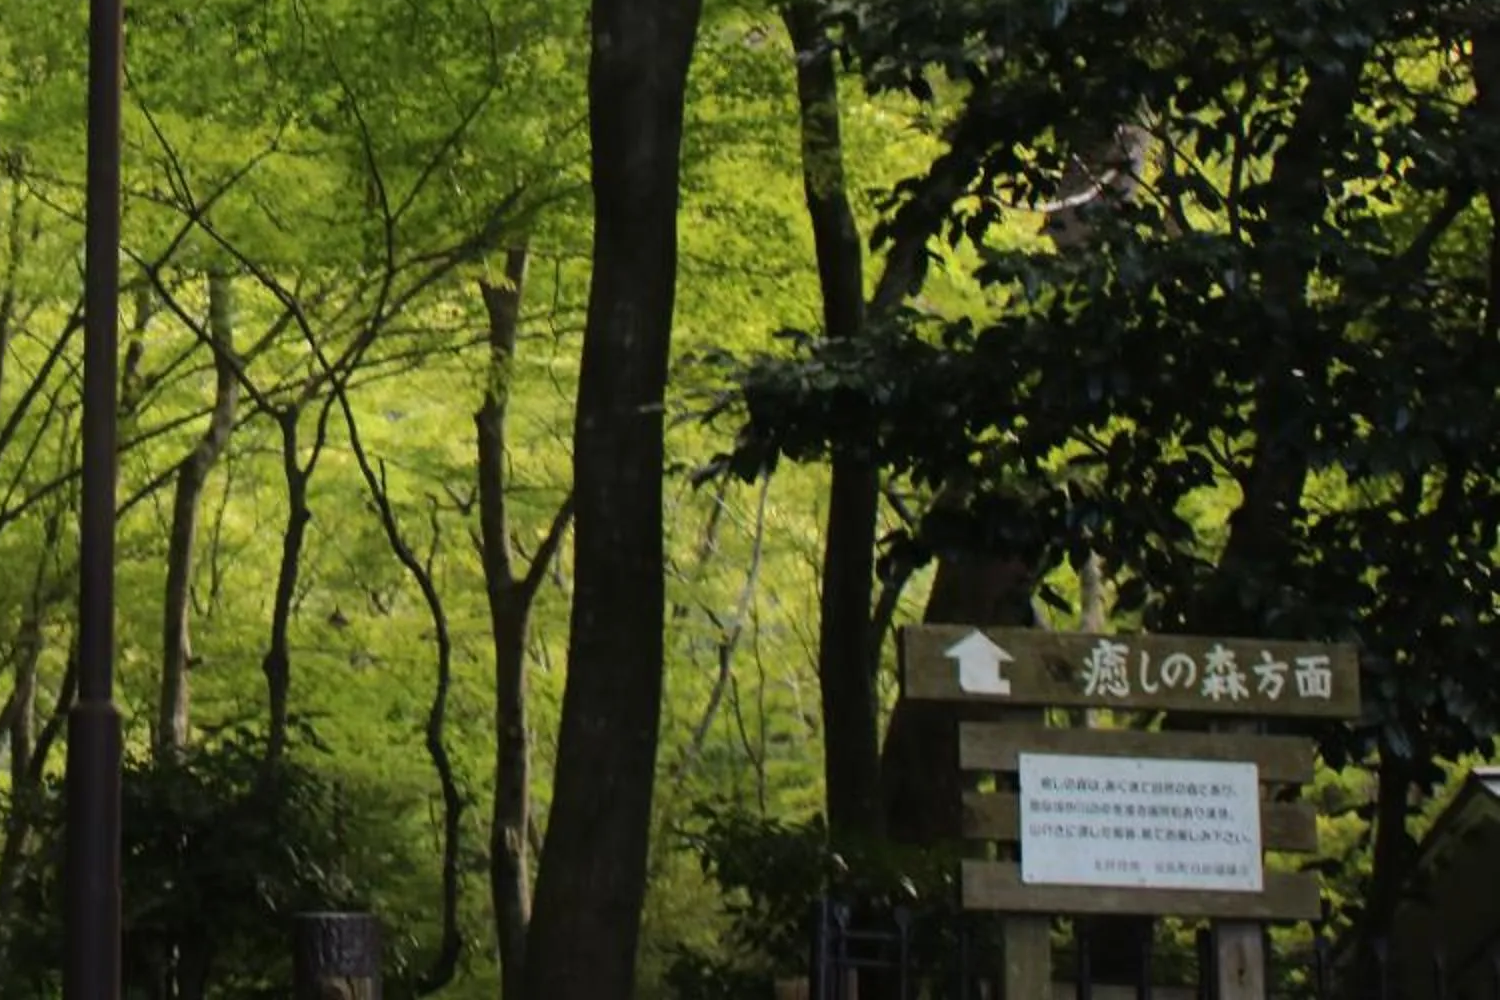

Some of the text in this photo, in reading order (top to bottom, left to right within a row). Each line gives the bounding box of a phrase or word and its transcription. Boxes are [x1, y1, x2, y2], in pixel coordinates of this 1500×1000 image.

[1081, 639, 1333, 702] 癒しの森方面
